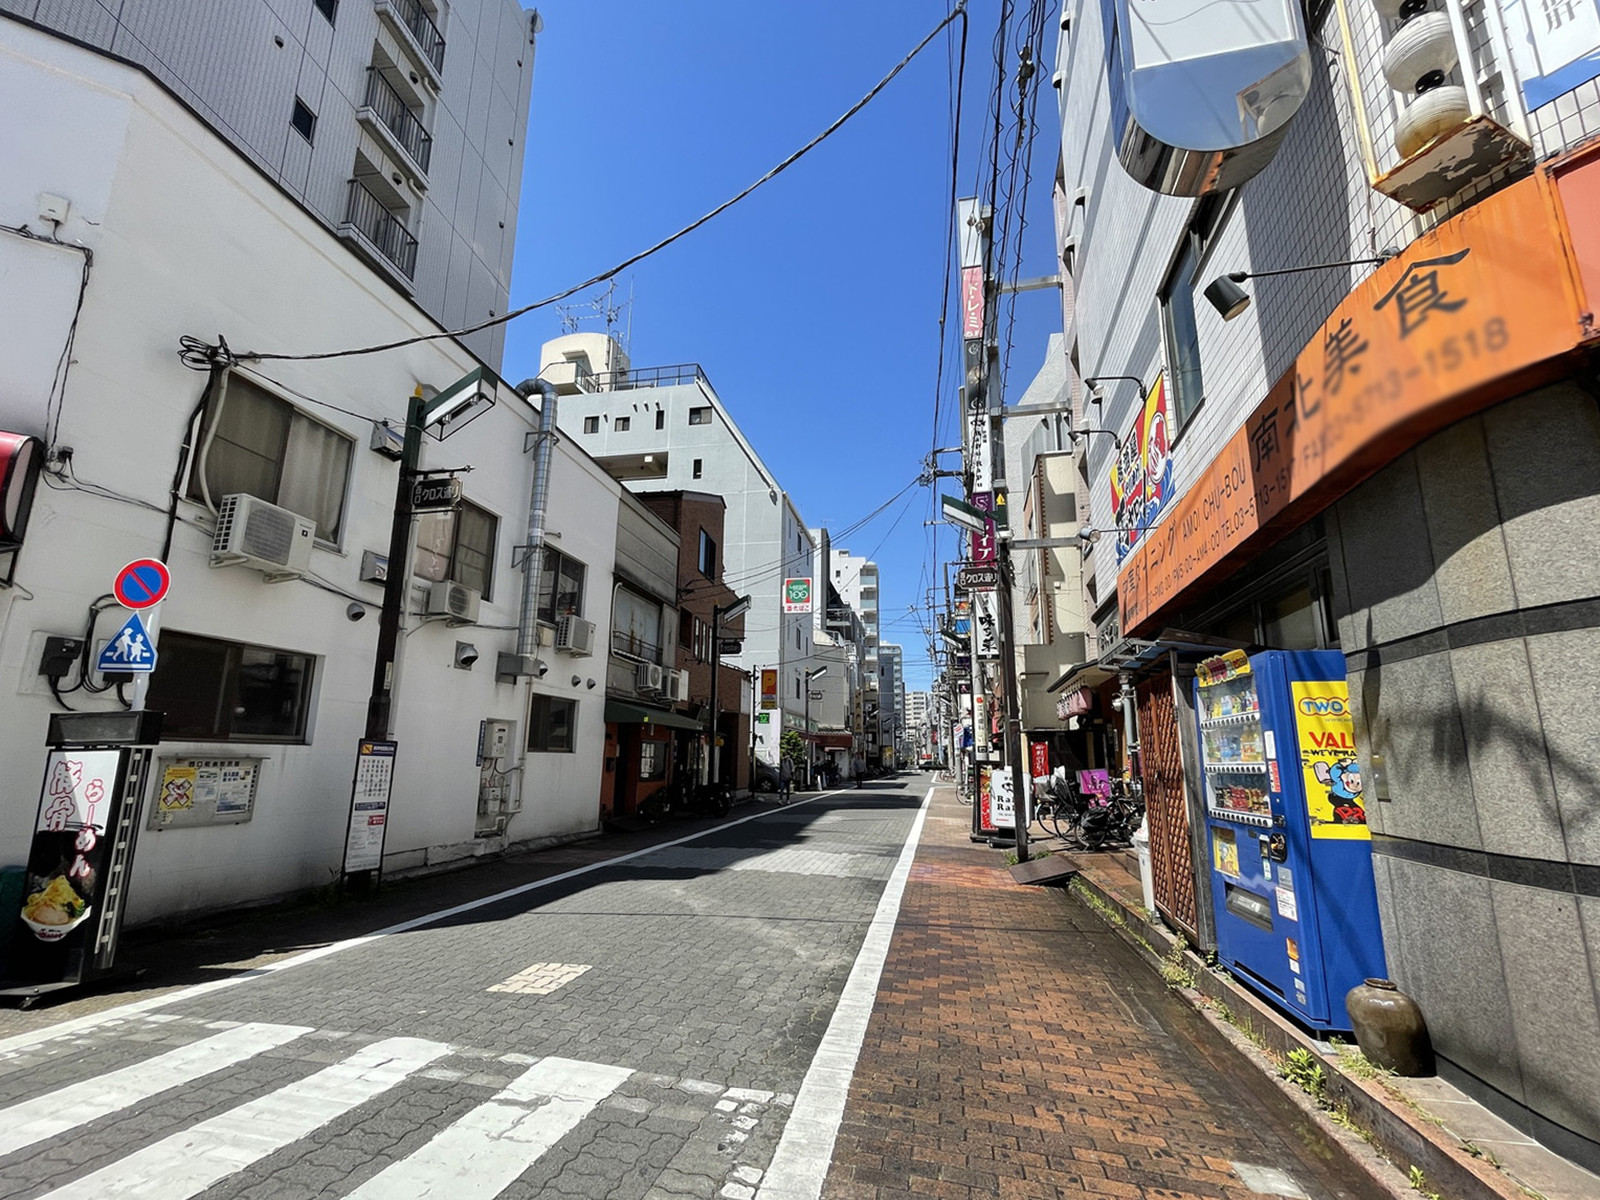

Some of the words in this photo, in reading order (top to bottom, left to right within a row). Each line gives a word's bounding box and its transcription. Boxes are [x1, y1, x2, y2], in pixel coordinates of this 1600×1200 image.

[1250, 247, 1471, 473] 南北美食
[1182, 507, 1201, 543] AMOI
[1202, 457, 1246, 521] CHU-BOU
[789, 590, 808, 599] 100
[1303, 701, 1344, 713] TWO
[69, 778, 105, 877] らーめん
